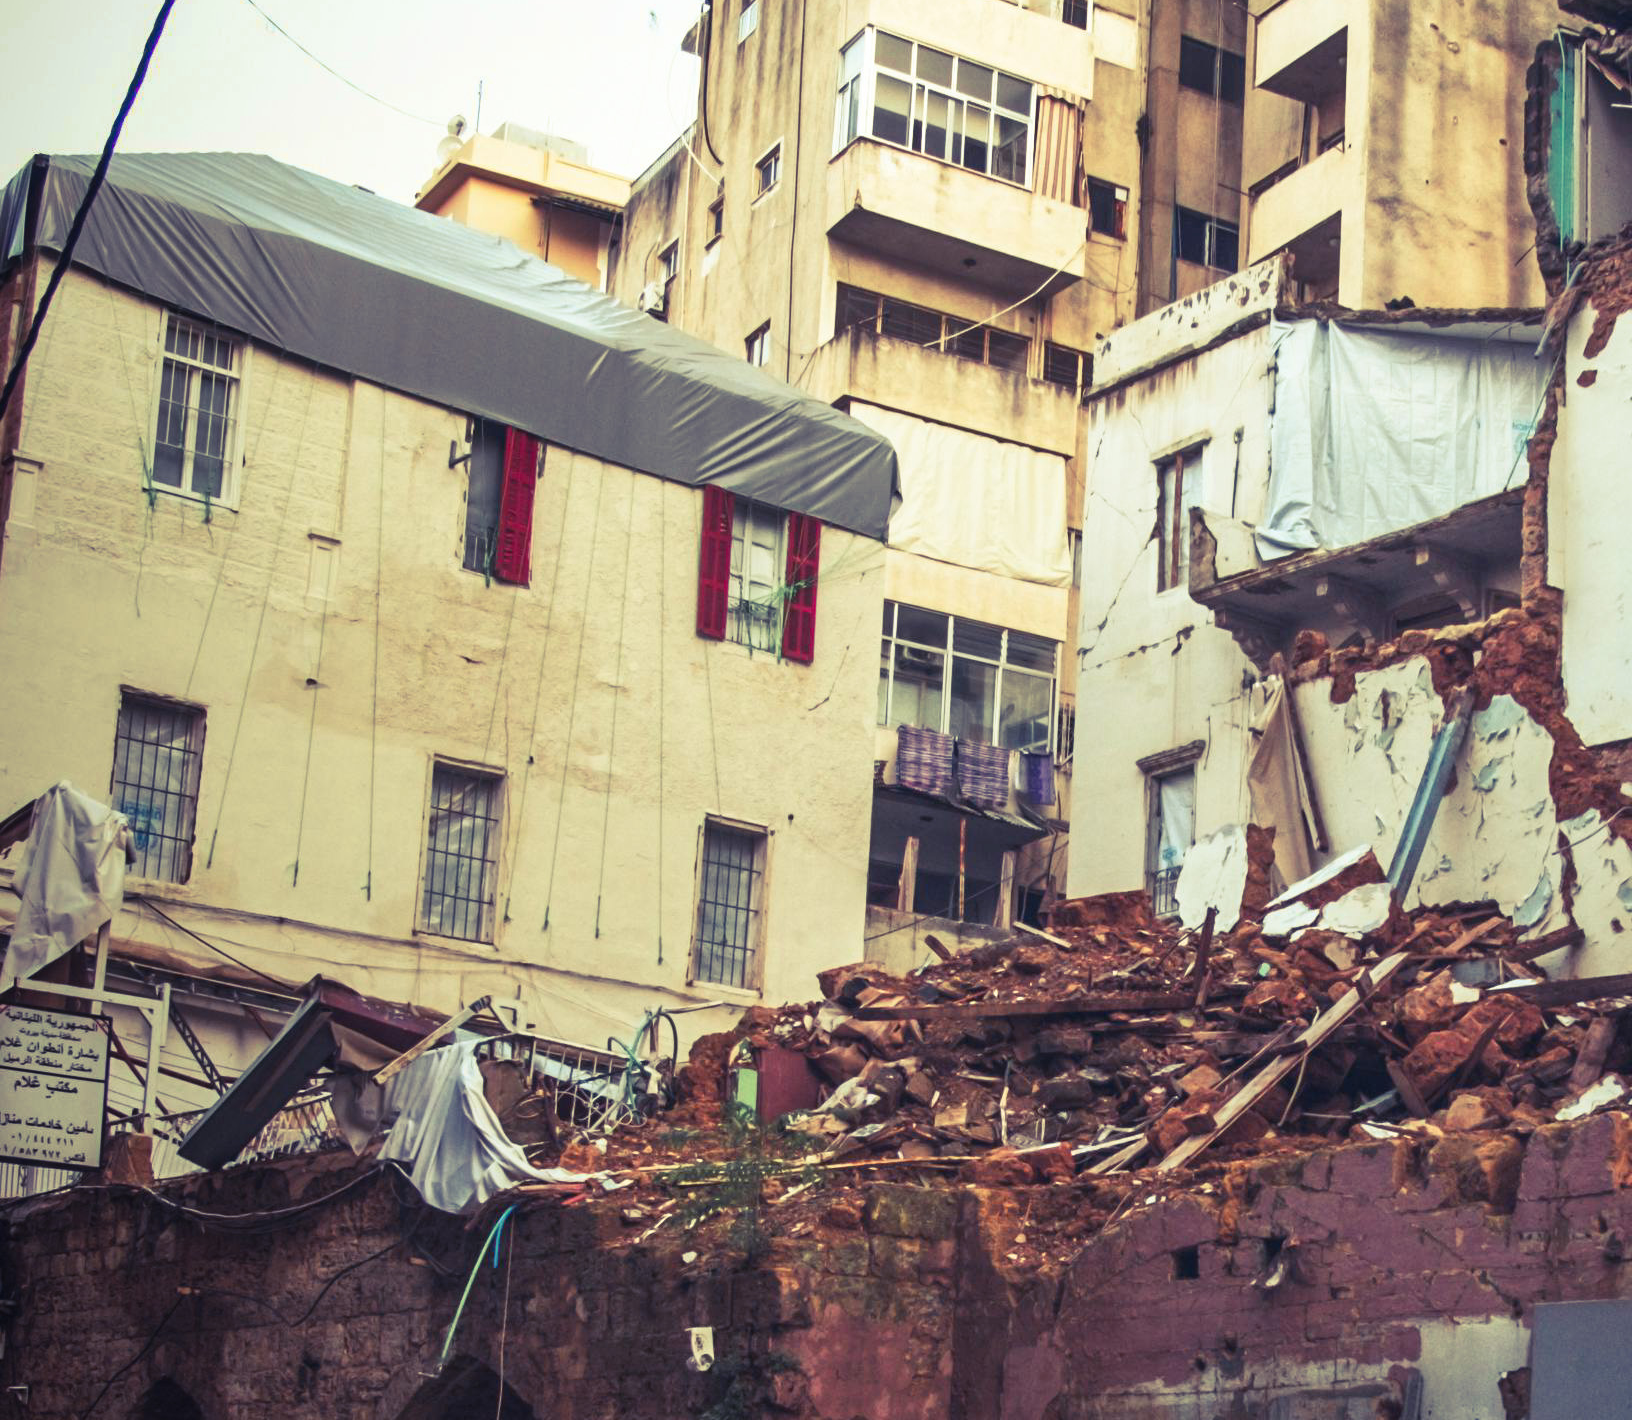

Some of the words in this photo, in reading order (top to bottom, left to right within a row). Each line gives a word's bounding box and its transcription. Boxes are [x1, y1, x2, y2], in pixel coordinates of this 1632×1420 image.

[5, 1008, 43, 1024] اللبنانية
[46, 1015, 97, 1033] الجمهورية
[3, 1052, 33, 1066] الرميل
[68, 1045, 100, 1062] بشارة
[34, 1055, 63, 1069] منطقة
[14, 1075, 41, 1092] غلام
[0, 1111, 22, 1126] مناز
